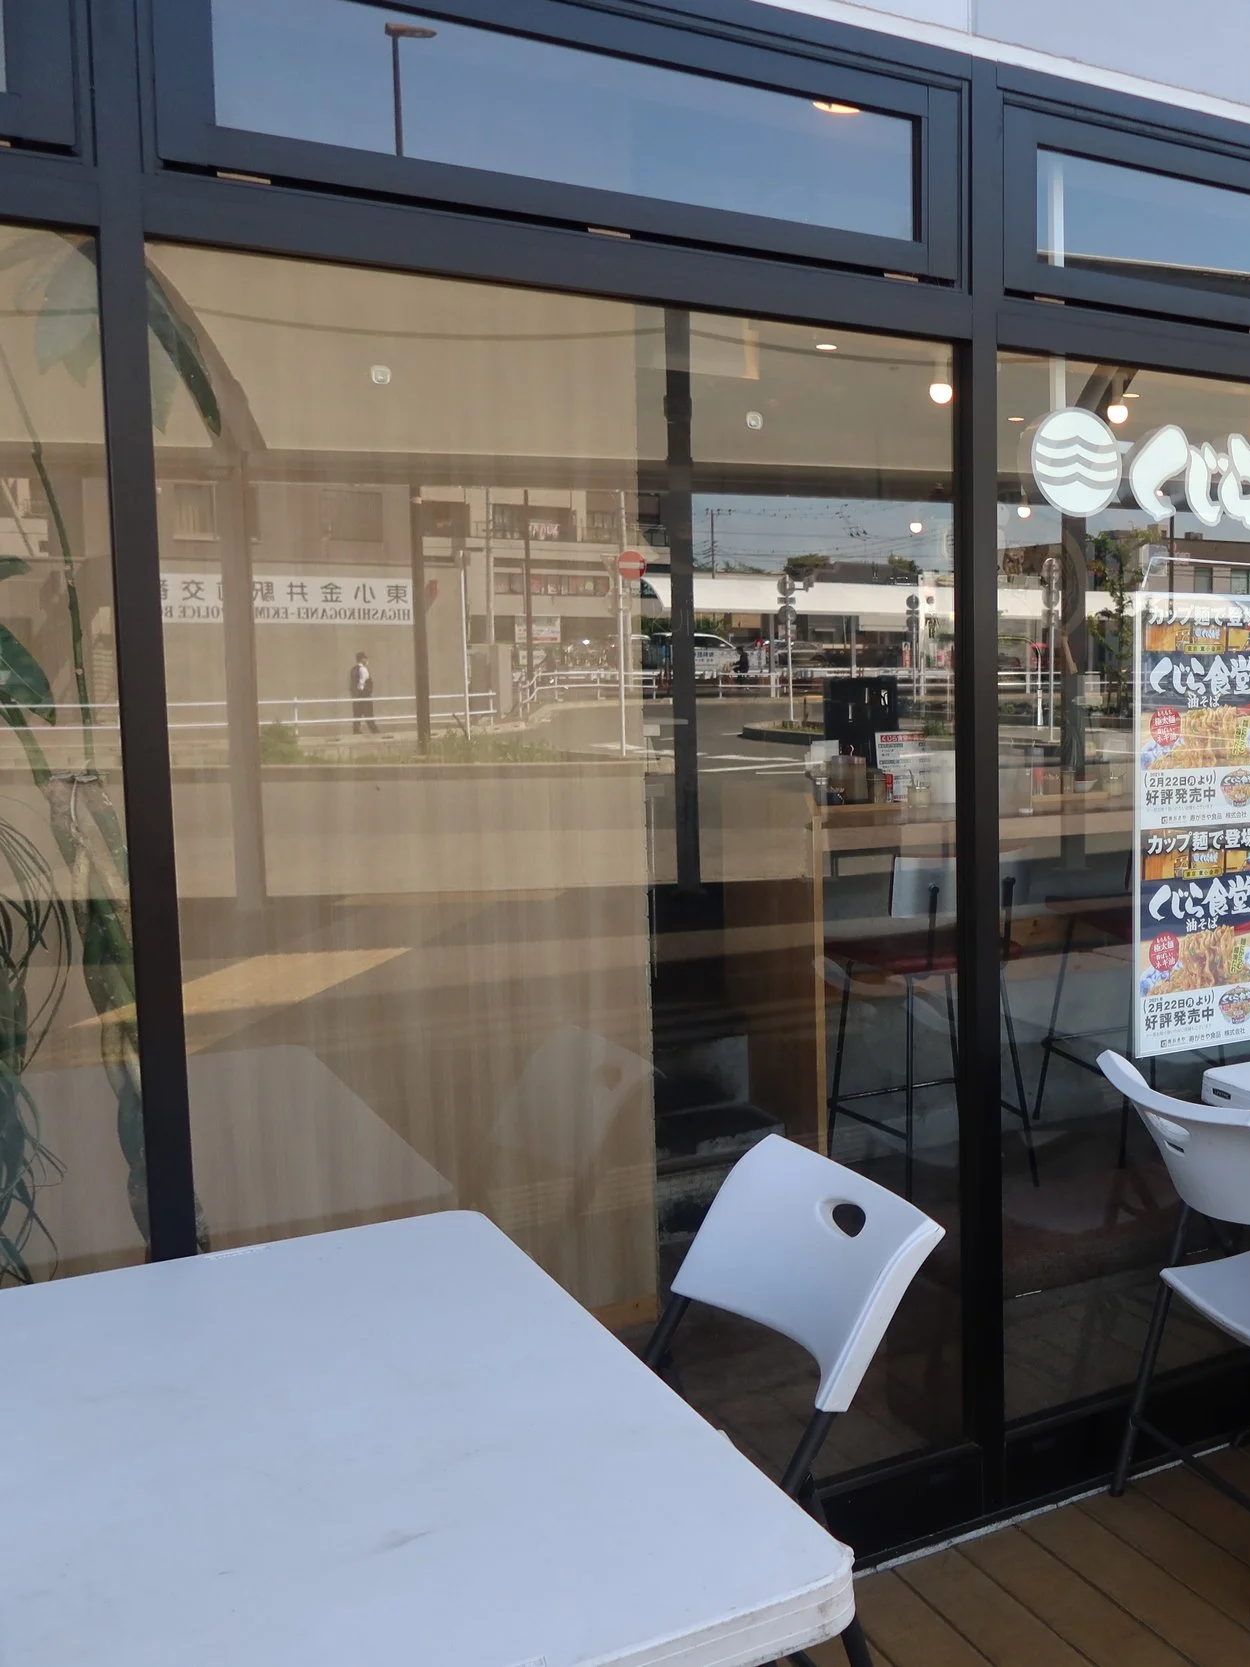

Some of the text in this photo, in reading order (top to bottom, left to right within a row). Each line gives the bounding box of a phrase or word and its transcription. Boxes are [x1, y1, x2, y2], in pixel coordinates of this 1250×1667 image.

[1187, 694, 1220, 708] 油そば
[1146, 787, 1216, 806] 好評発売中
[1186, 916, 1219, 932] 油そば
[1145, 1006, 1214, 1031] 好評発売中
